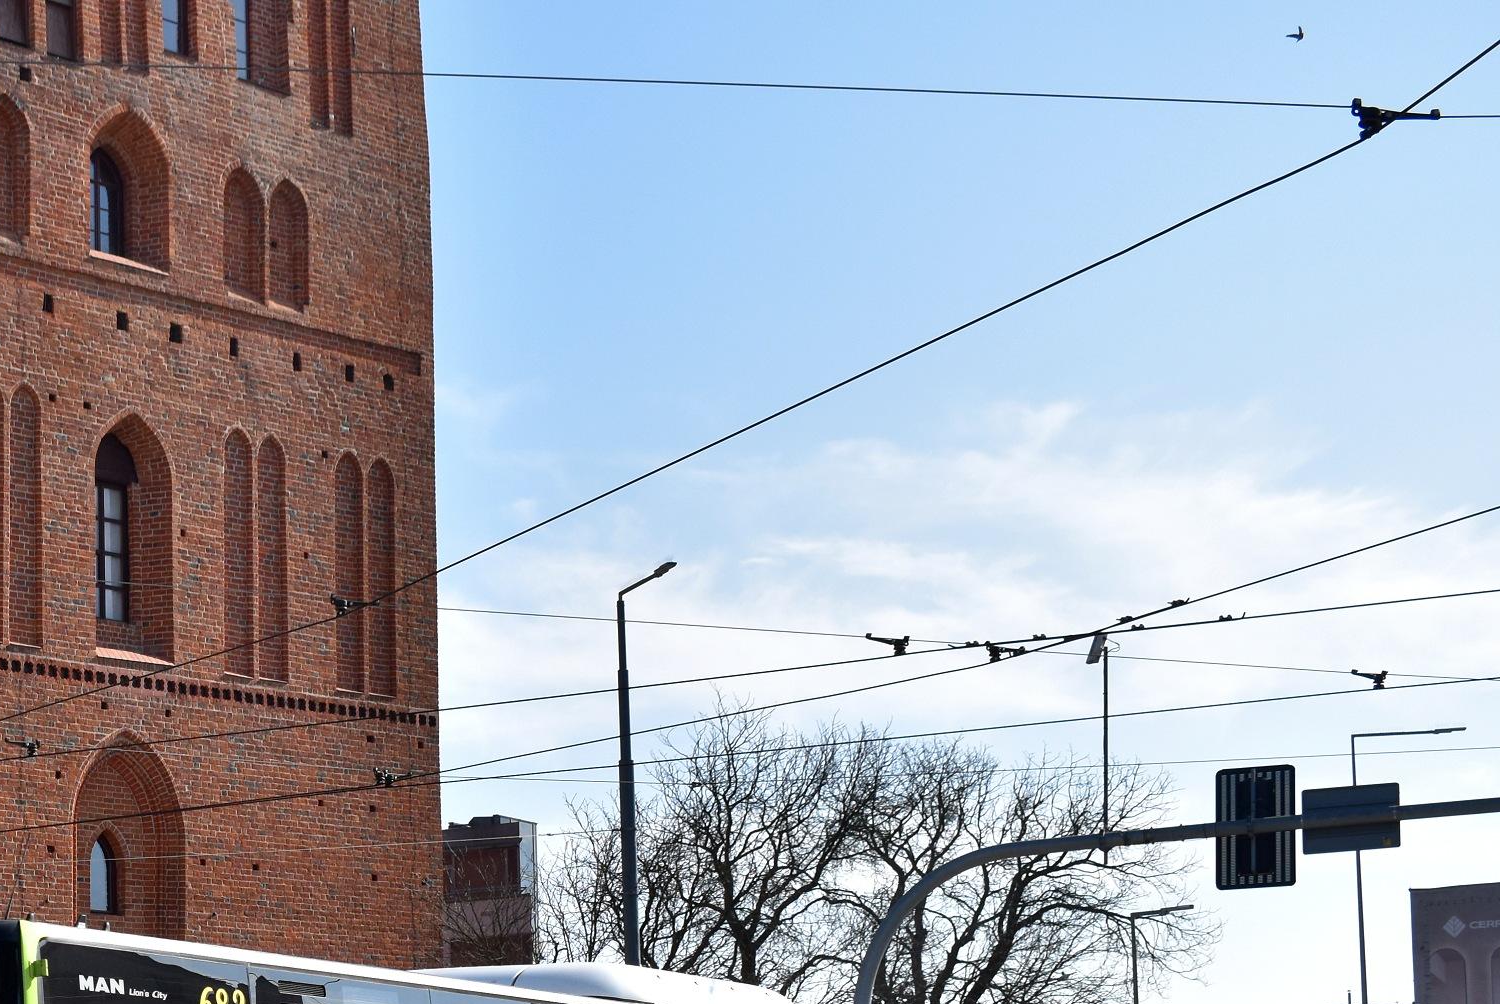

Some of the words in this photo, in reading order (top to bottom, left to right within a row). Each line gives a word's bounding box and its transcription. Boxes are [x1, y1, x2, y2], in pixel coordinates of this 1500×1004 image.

[78, 975, 125, 995] MAN
[129, 988, 150, 997] Lion's
[152, 990, 168, 1001] City
